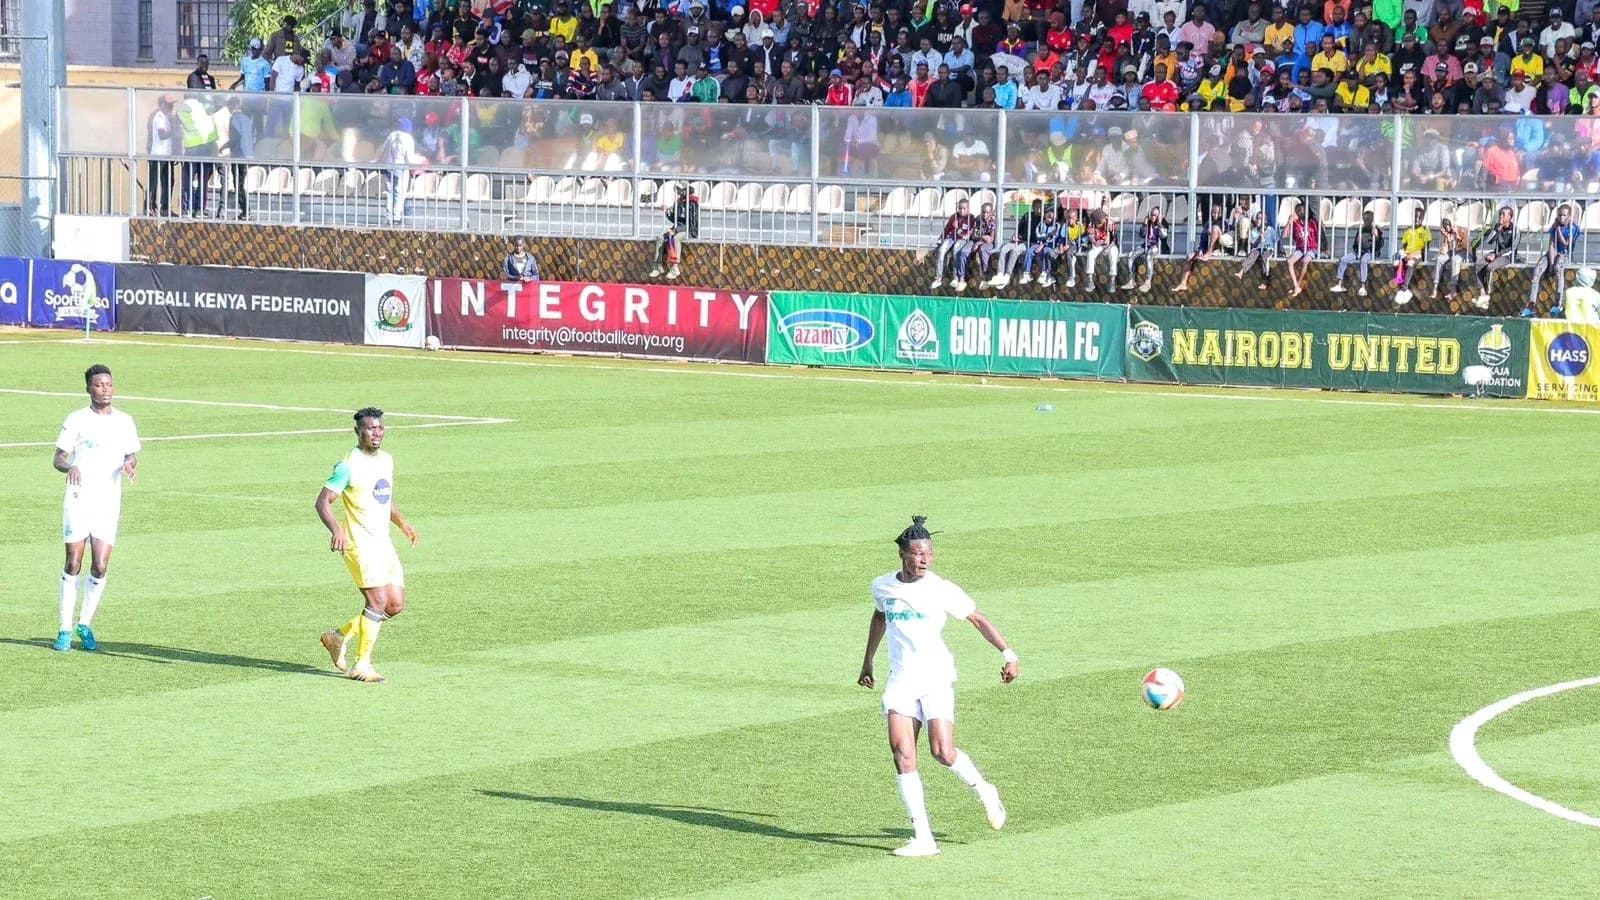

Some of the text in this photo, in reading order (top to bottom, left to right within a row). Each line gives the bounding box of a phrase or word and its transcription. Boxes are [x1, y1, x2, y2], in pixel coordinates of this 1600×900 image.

[115, 289, 350, 316] FOOTBALL KENYA FEDERATION
[434, 279, 758, 330] INTEGRITY
[502, 325, 685, 350] integrity@footballkenya.org
[950, 315, 1100, 362] GOR MAHIA FC
[1172, 328, 1461, 375] NAIROBI UNITED
[1550, 348, 1588, 363] HASS
[1537, 382, 1599, 393] SERVICING
